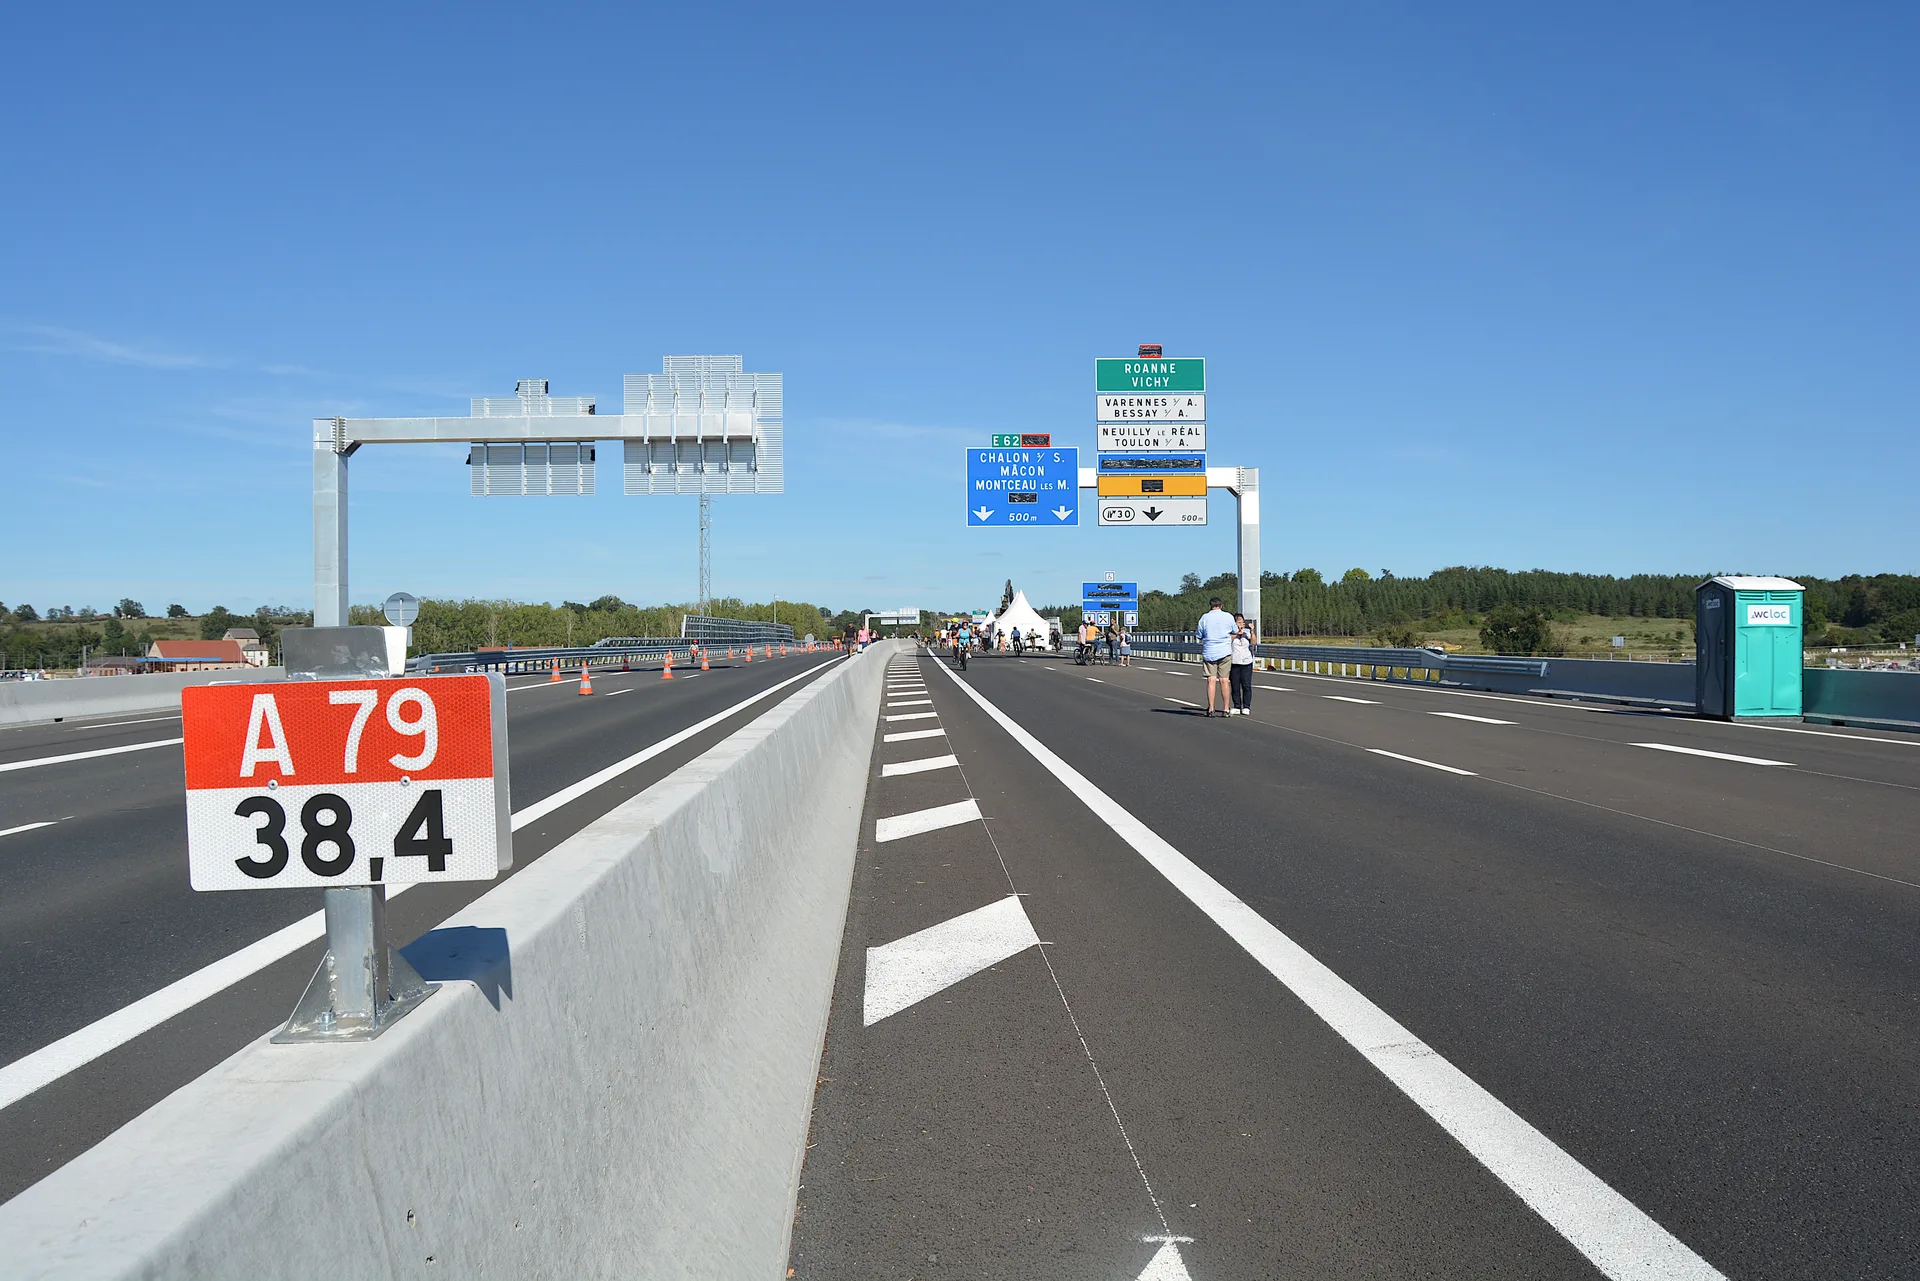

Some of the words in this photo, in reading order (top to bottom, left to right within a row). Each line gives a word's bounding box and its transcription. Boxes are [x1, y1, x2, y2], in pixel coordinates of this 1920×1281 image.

[1124, 363, 1176, 374] ROANNE
[1131, 377, 1170, 387] VICHY
[1105, 399, 1167, 407] VARENNES
[1187, 399, 1197, 407] A.
[1114, 409, 1158, 418] BESSAY
[1178, 409, 1188, 418] A.
[1102, 428, 1151, 436] NEUILLY
[1171, 426, 1200, 436] RÉAL
[993, 436, 999, 446] E
[1003, 436, 1019, 446] 62
[1115, 439, 1159, 447] TOULON
[1178, 439, 1189, 447] A.
[980, 452, 1029, 463] CHALON
[1053, 452, 1065, 463] S.
[1000, 464, 1045, 476] MÂCON
[975, 480, 1037, 490] MONTCEAU
[1057, 480, 1070, 490] M.
[1117, 510, 1131, 518] 30
[239, 693, 295, 777] A
[328, 687, 438, 774] 79
[234, 789, 453, 882] 38,4
